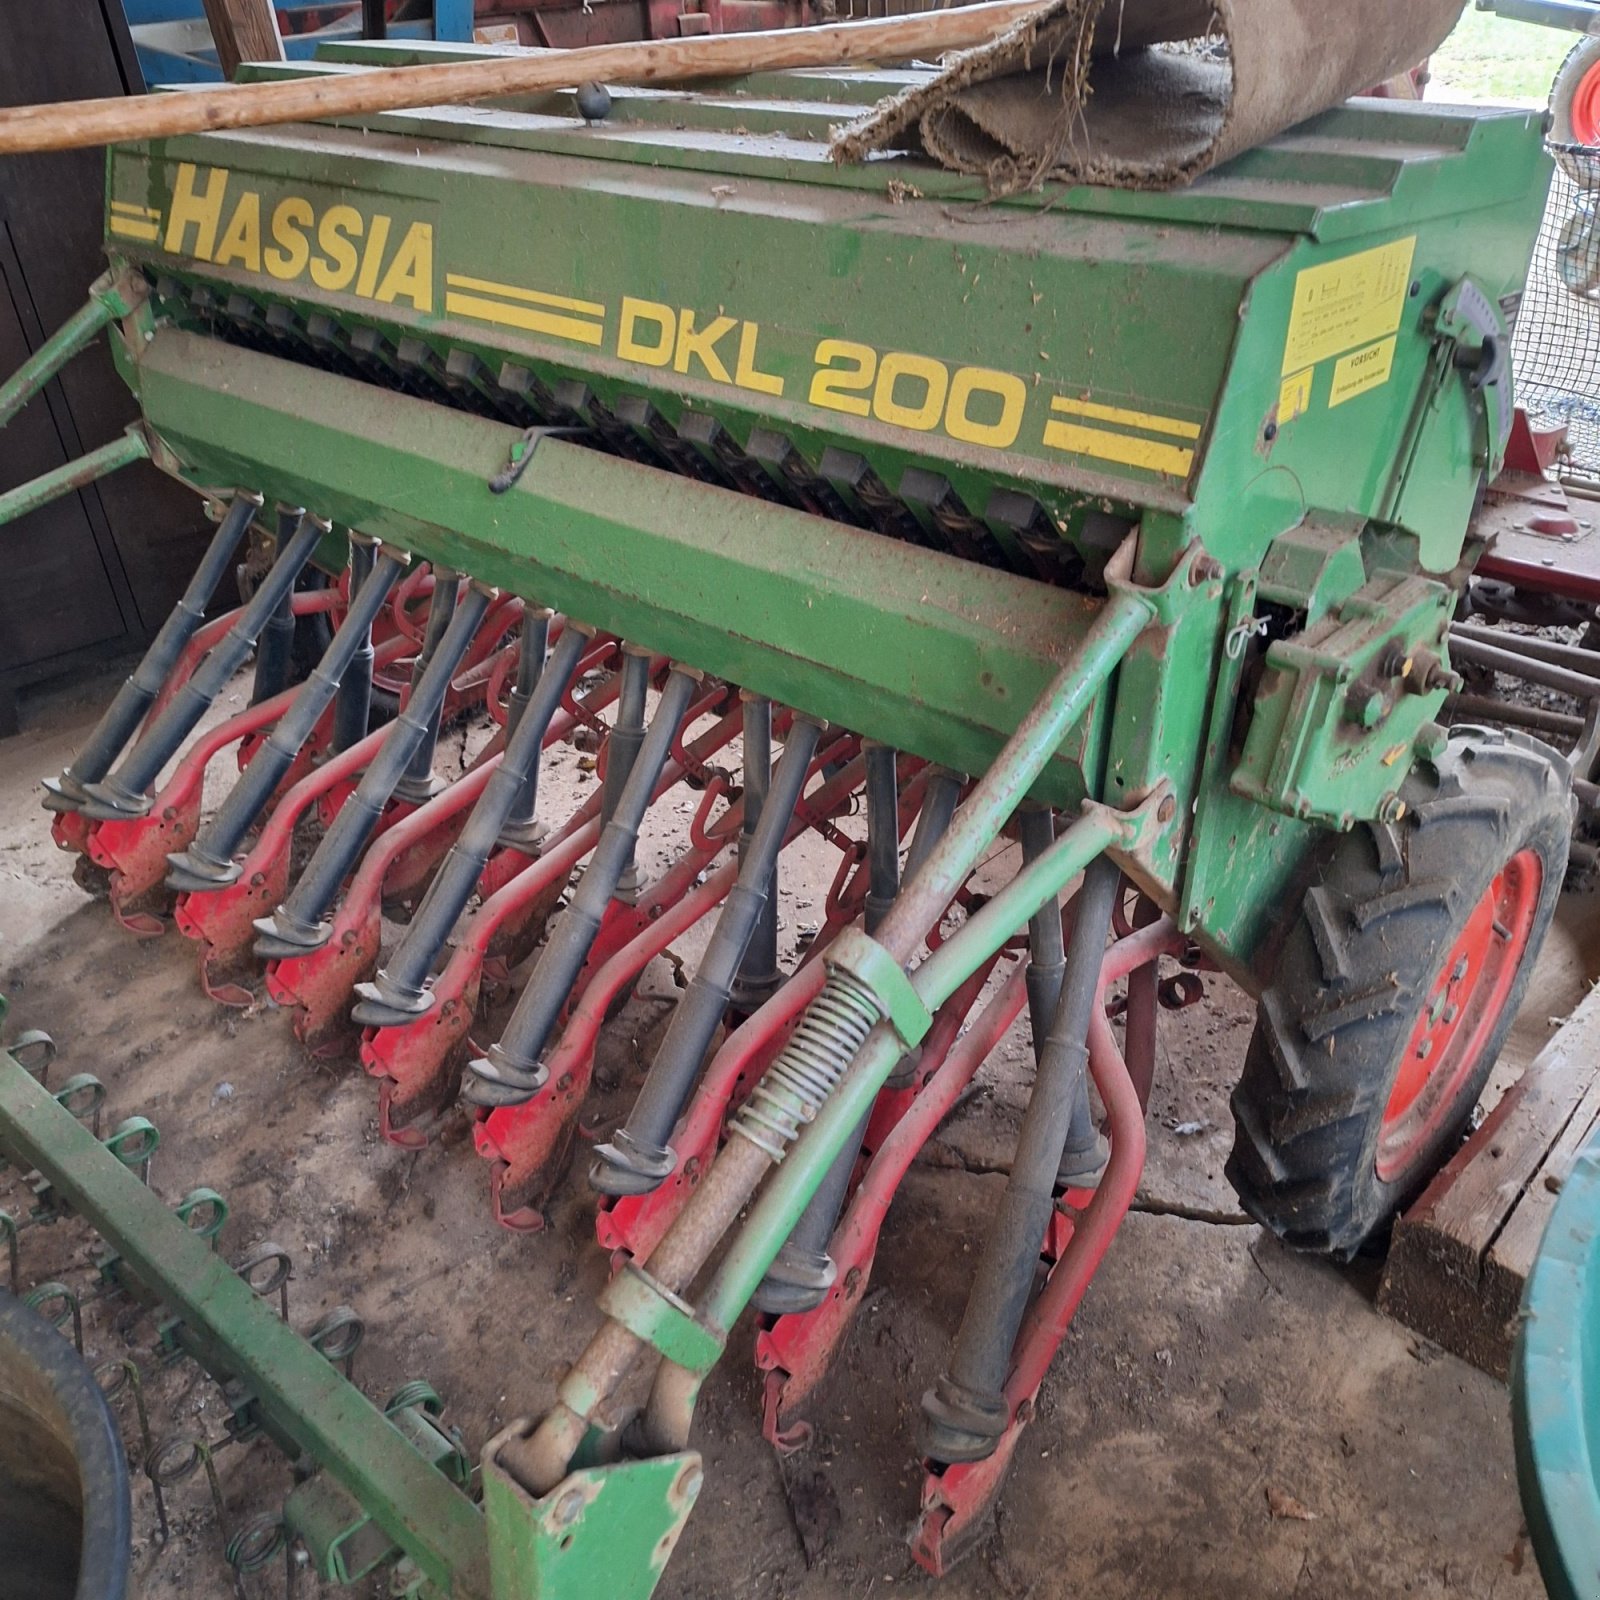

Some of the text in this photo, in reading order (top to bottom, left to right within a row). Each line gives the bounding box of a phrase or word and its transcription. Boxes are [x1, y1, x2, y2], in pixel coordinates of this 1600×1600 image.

[164, 163, 433, 312] HASSIA
[616, 296, 1026, 448] DKL 200
[1350, 347, 1380, 368] VORSICHT
